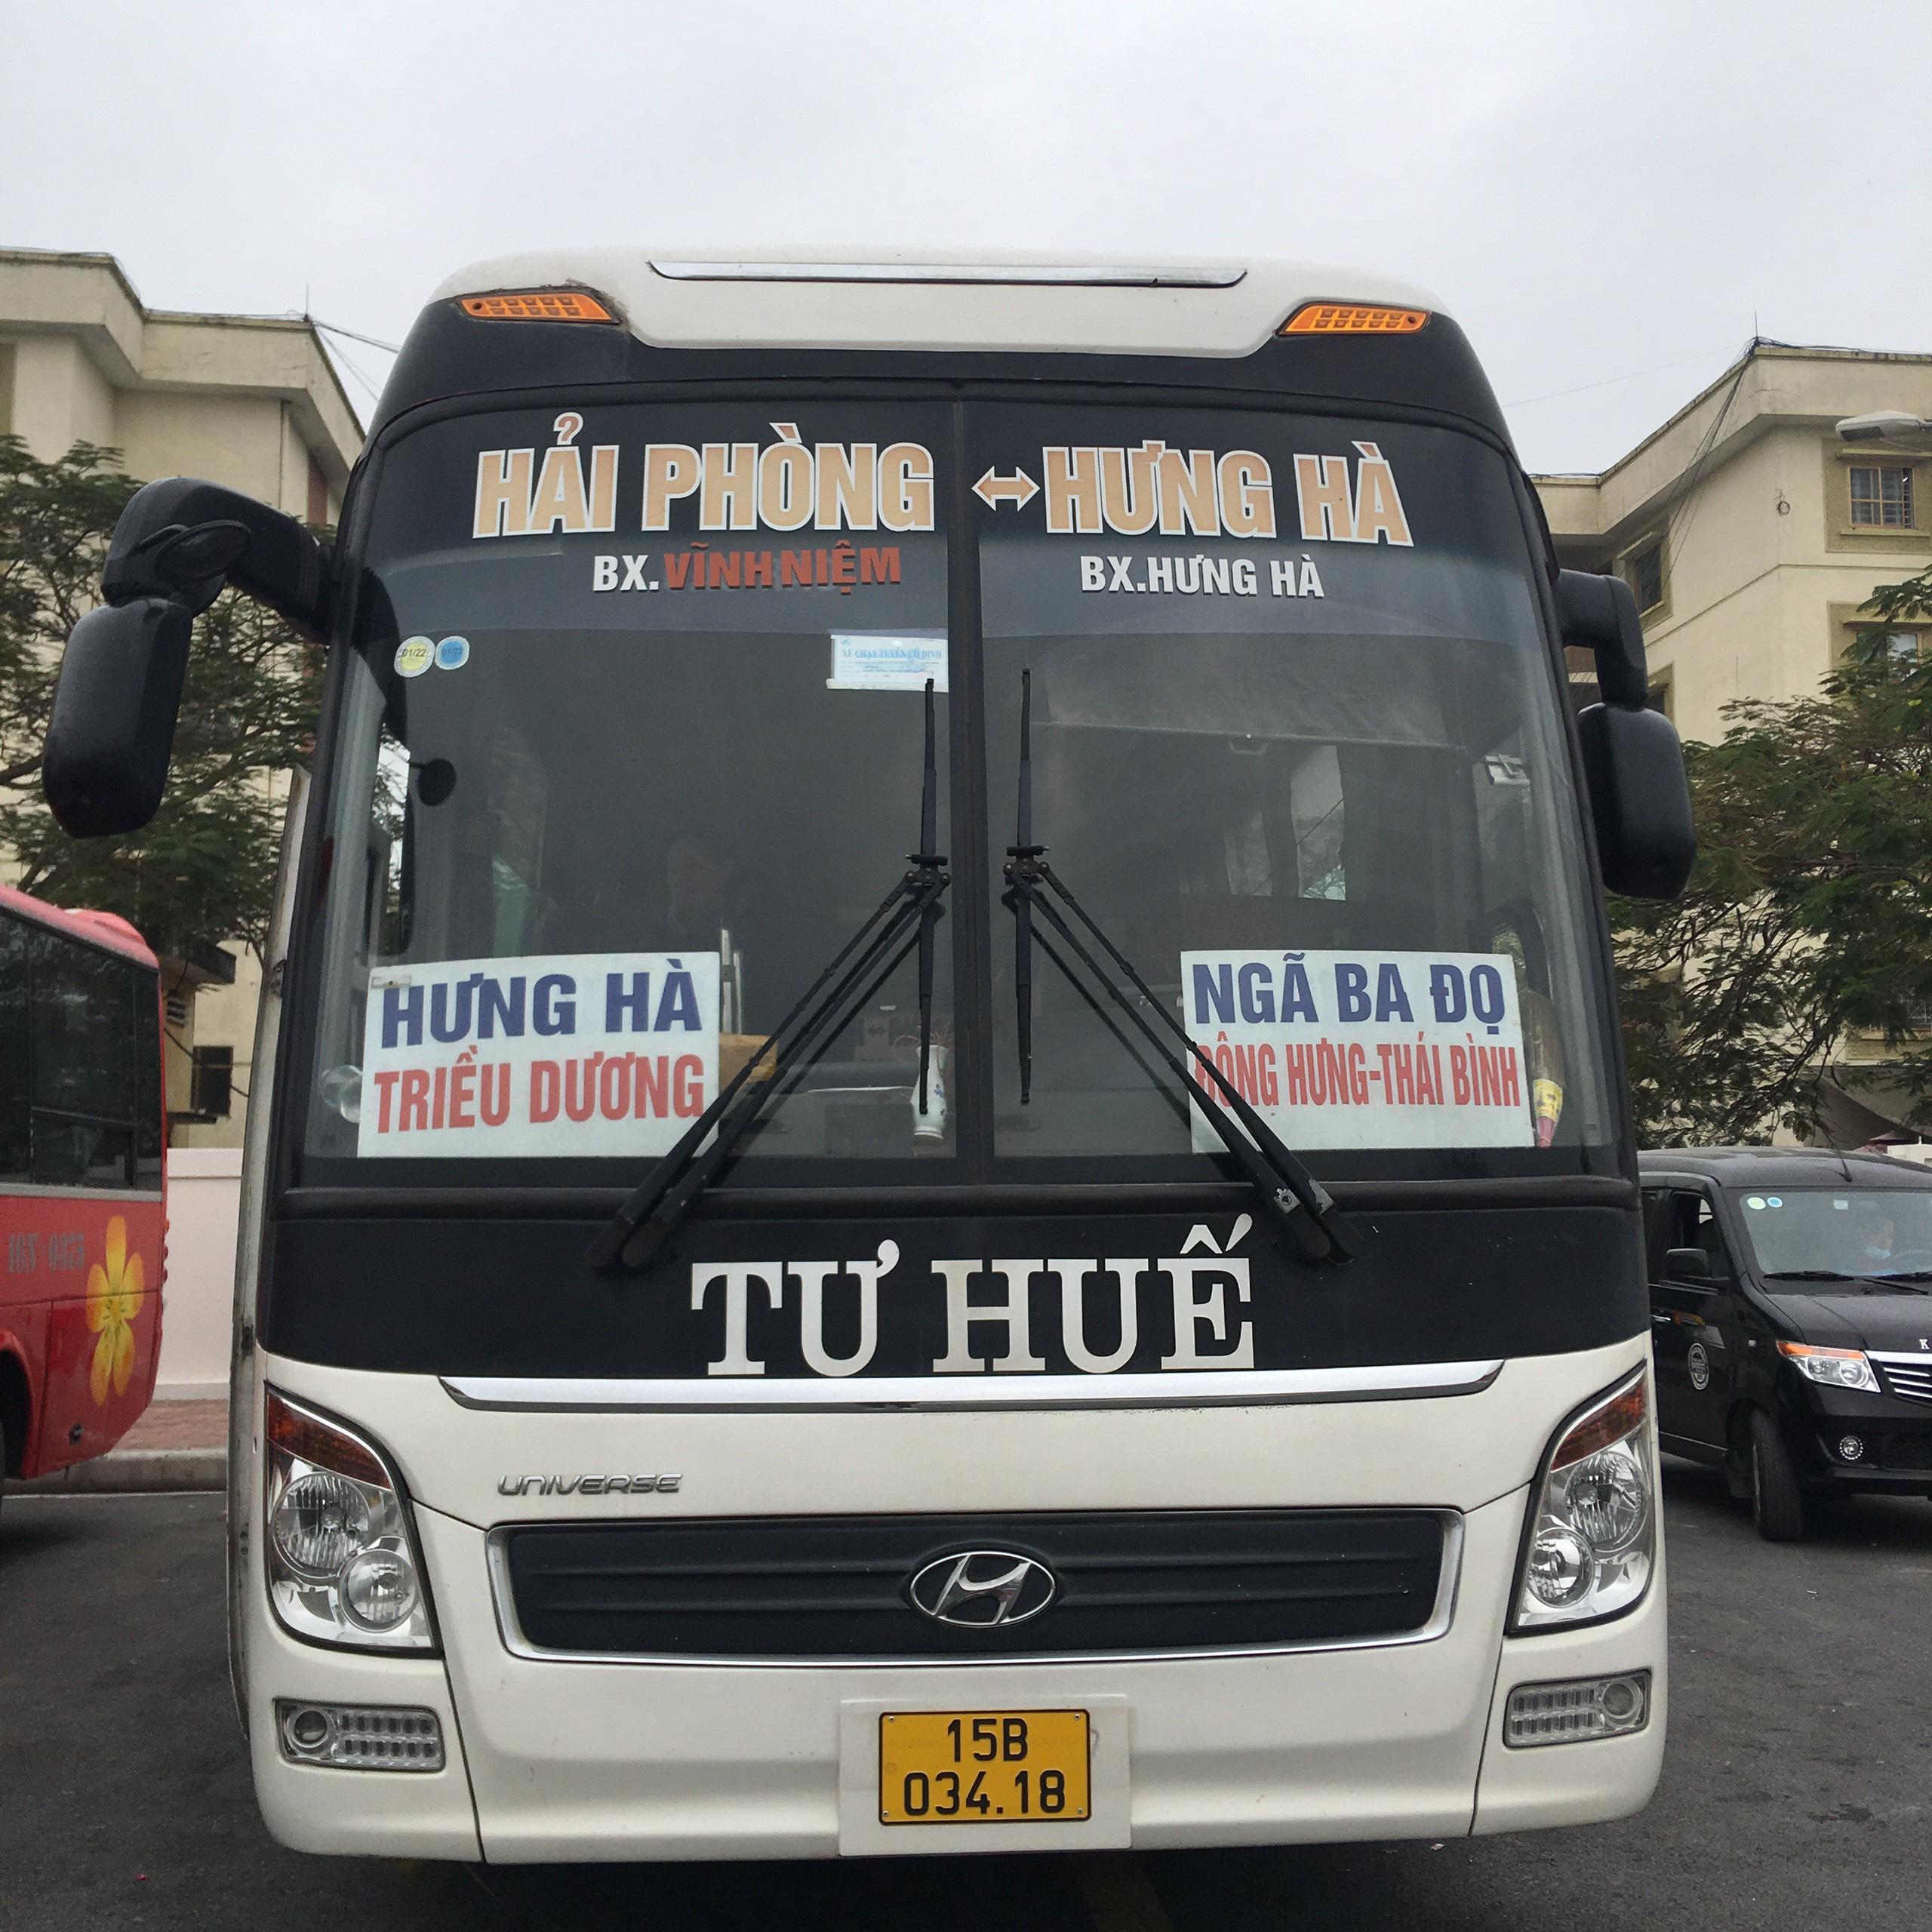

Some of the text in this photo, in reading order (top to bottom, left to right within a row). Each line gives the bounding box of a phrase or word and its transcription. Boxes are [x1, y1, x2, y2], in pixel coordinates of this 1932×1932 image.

[472, 411, 935, 539] HẢI PHÒNG
[1042, 439, 1415, 548] HƯNG HÀ
[780, 538, 902, 595] NIỆM
[1270, 554, 1325, 598] HÀ
[380, 958, 703, 1049] HƯNG HÀ
[1192, 952, 1506, 1035] NGÃ BA ĐỌ
[374, 1044, 705, 1134] TRIỀU DƯƠNG
[1450, 1032, 1521, 1107] BÌNH
[690, 1212, 1255, 1377] TƯ HUẾ
[497, 1472, 683, 1496] UNIVERSE
[947, 1717, 1029, 1763] 15B
[903, 1769, 1066, 1816] 034.18
